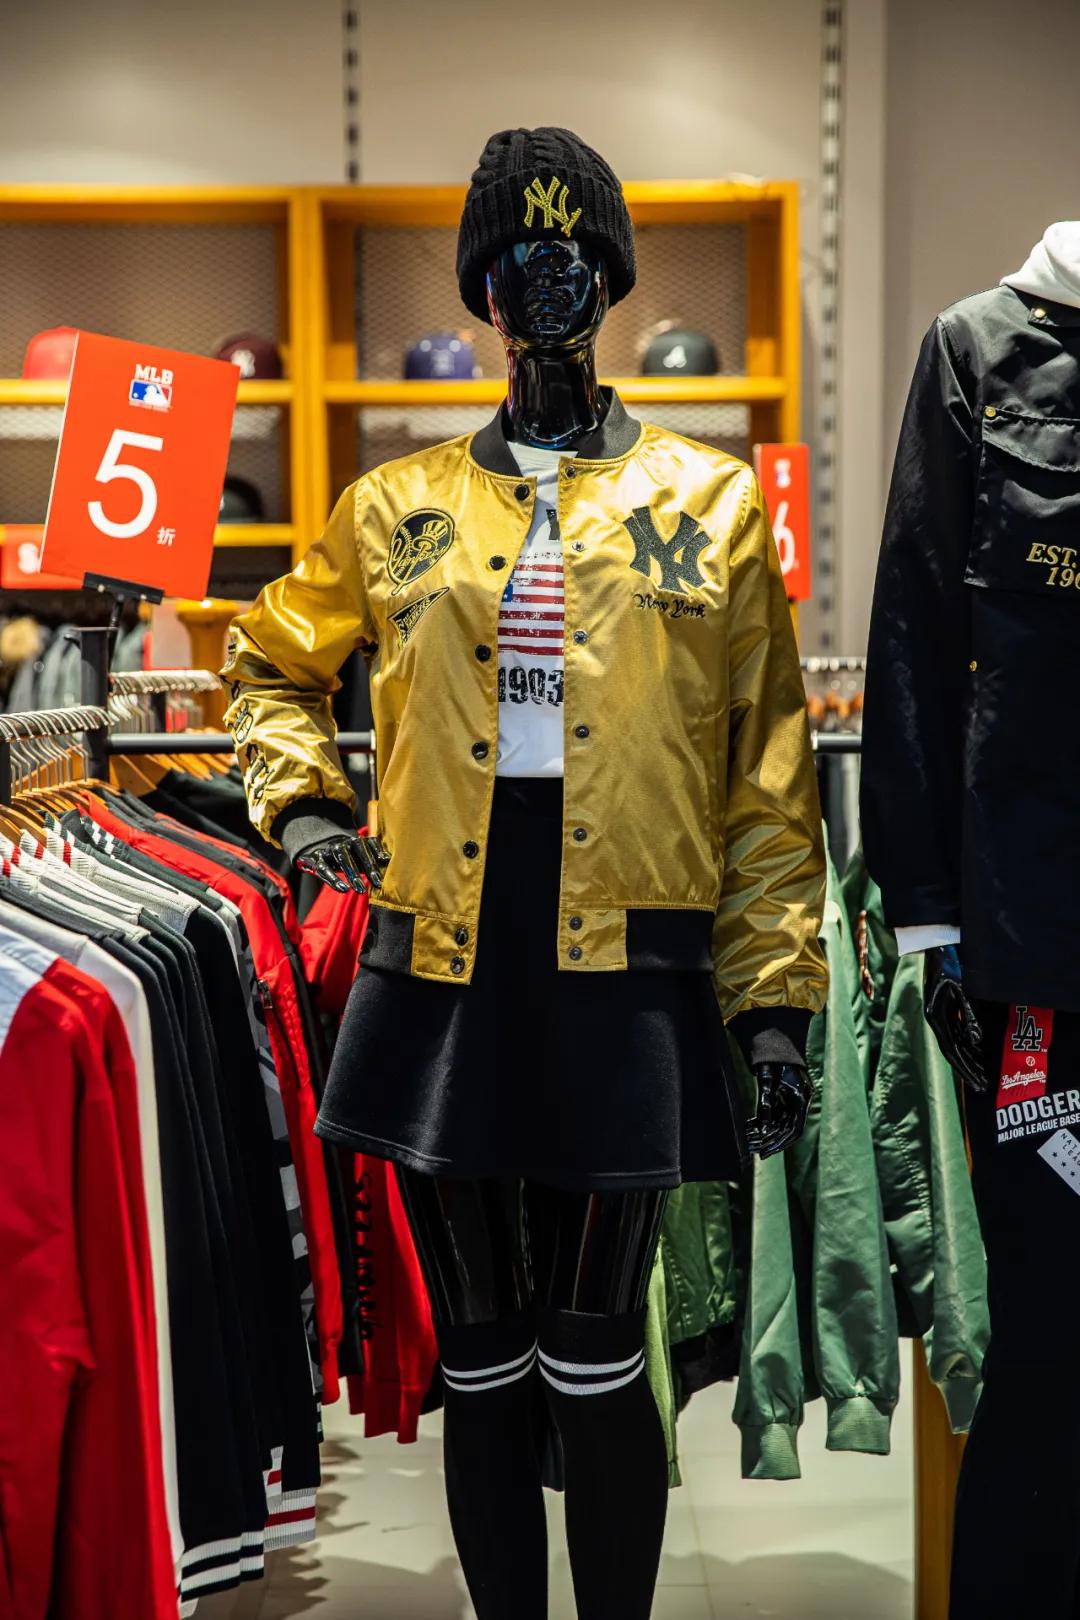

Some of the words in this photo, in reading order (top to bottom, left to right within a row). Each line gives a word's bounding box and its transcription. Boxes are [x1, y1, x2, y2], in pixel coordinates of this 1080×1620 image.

[134, 363, 174, 385] MLB
[88, 428, 164, 539] 5
[157, 526, 176, 546] 折
[1026, 542, 1077, 569] EST.
[632, 594, 669, 611] New
[671, 599, 706, 618] York
[498, 666, 564, 707] 1903
[1011, 1006, 1043, 1051] LA
[997, 1127, 1025, 1144] MAJOR
[1025, 1118, 1059, 1135] LEAGUE
